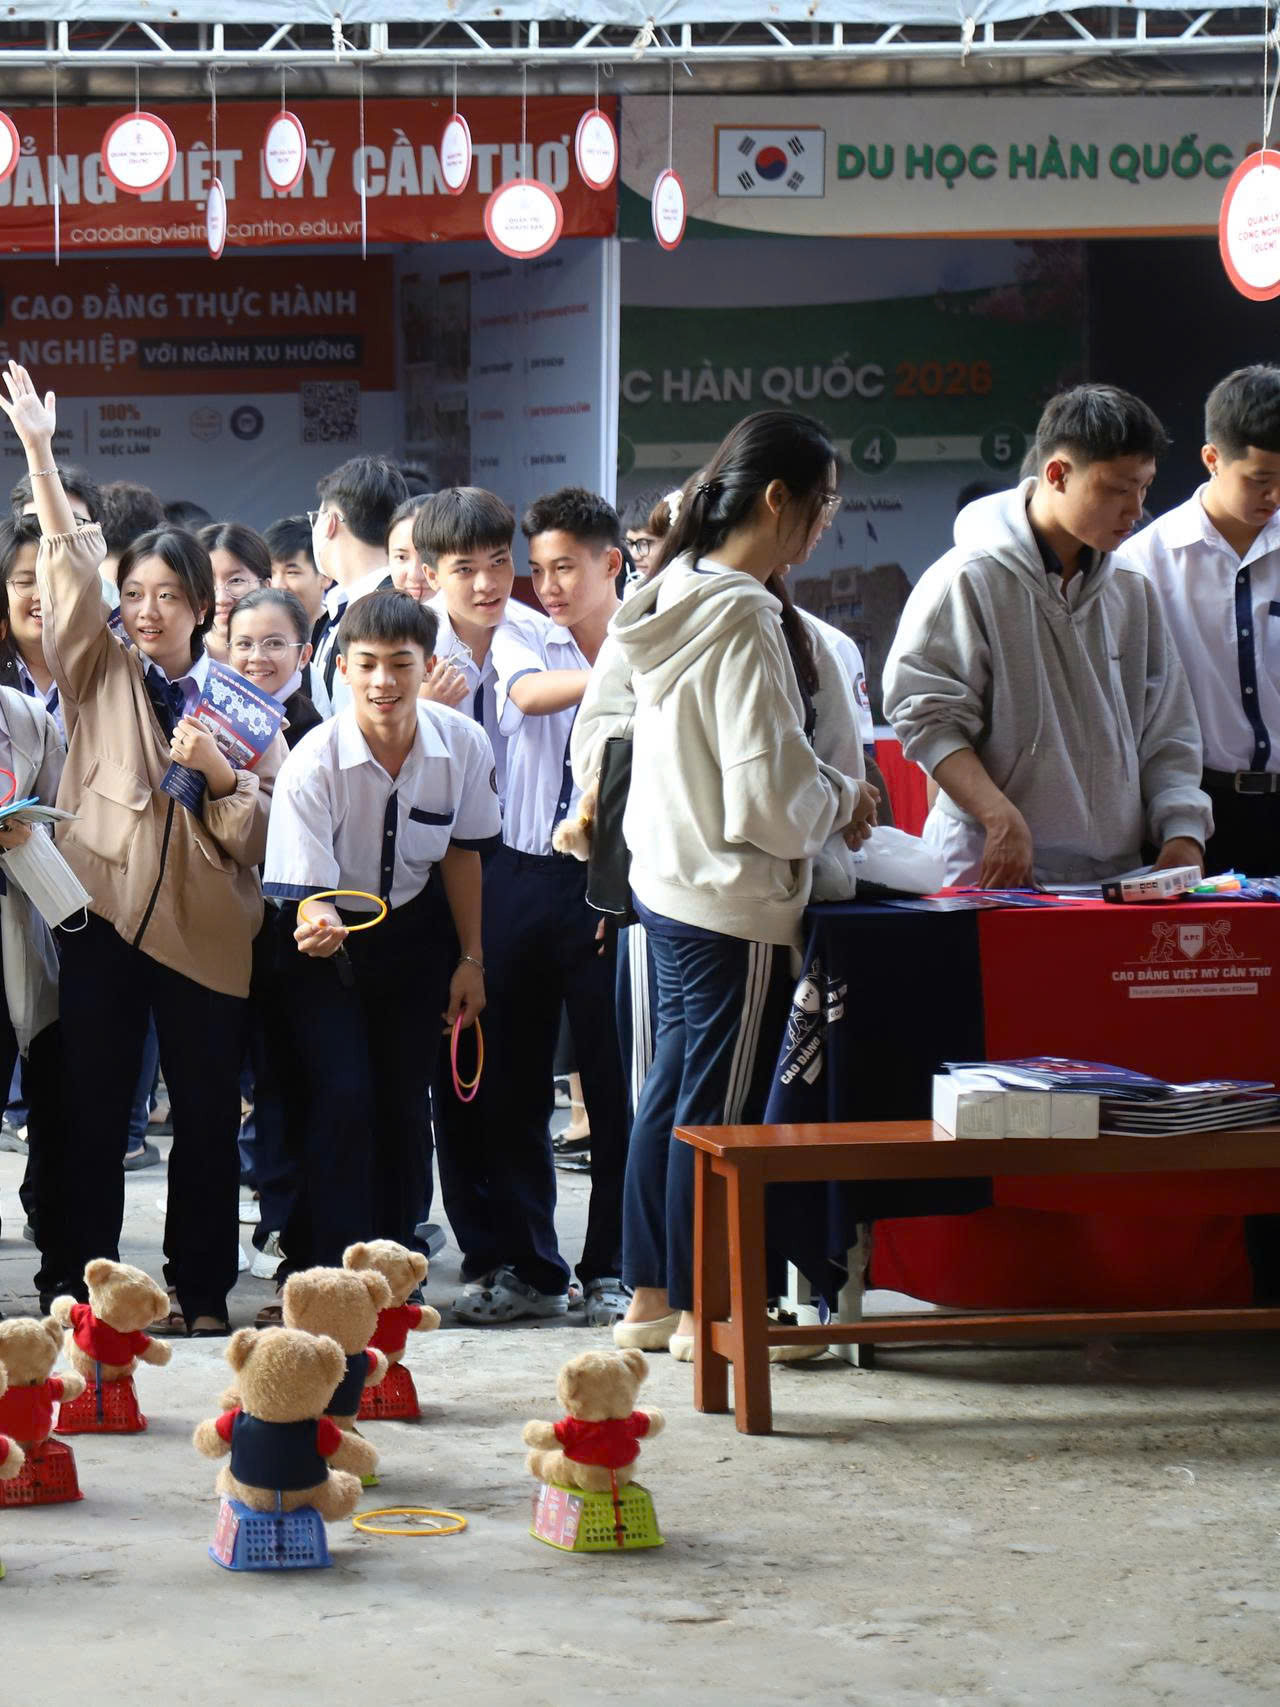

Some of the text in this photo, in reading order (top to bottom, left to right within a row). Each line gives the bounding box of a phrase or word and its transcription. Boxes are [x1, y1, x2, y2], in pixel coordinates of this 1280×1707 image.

[352, 128, 448, 197] CẦN
[471, 134, 571, 195] THƠ
[838, 143, 894, 179] DU
[906, 142, 996, 188] HỌC
[1009, 134, 1097, 179] HÀN
[1110, 133, 1233, 184] QUỐC
[10, 295, 73, 320] CAO
[82, 283, 169, 320] ĐẲNG
[176, 286, 263, 325] THỰC
[271, 284, 357, 317] HÀNH
[18, 332, 137, 372] NGHIỆP
[182, 341, 250, 362] NGÀNH
[254, 345, 281, 361] XU
[662, 358, 752, 402] HÀN
[760, 352, 886, 405] QUỐC
[893, 359, 993, 398] 2026
[98, 404, 141, 421] 100%
[863, 437, 882, 464] 4
[994, 436, 1012, 462] 5
[1111, 971, 1135, 981] CAO
[1136, 966, 1169, 980] ĐẲNG
[1172, 967, 1198, 981] VIỆT
[1248, 966, 1273, 977] THƠ
[801, 988, 814, 1004] APC
[780, 1063, 801, 1084] CAO
